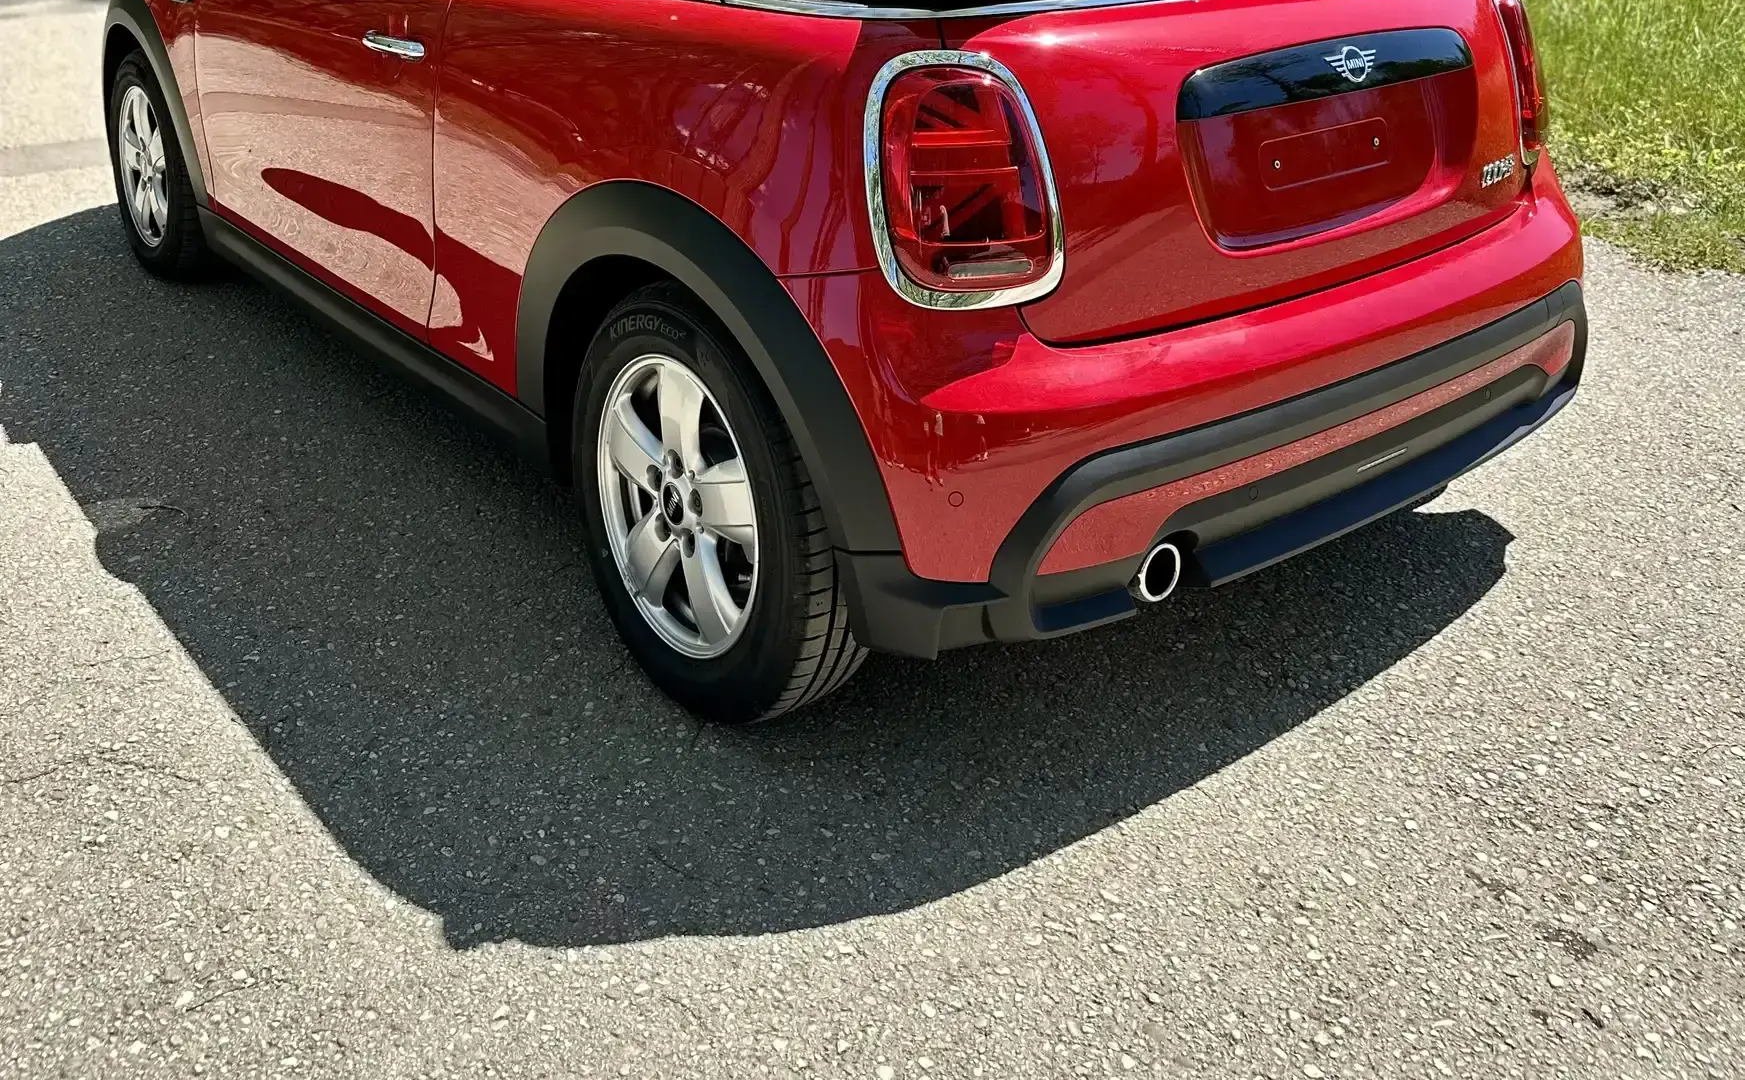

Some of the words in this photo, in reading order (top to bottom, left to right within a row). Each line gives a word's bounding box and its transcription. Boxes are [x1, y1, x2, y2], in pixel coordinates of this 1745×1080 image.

[1346, 57, 1365, 70] MINI
[610, 314, 664, 341] KINERGY
[666, 491, 680, 517] MINI
